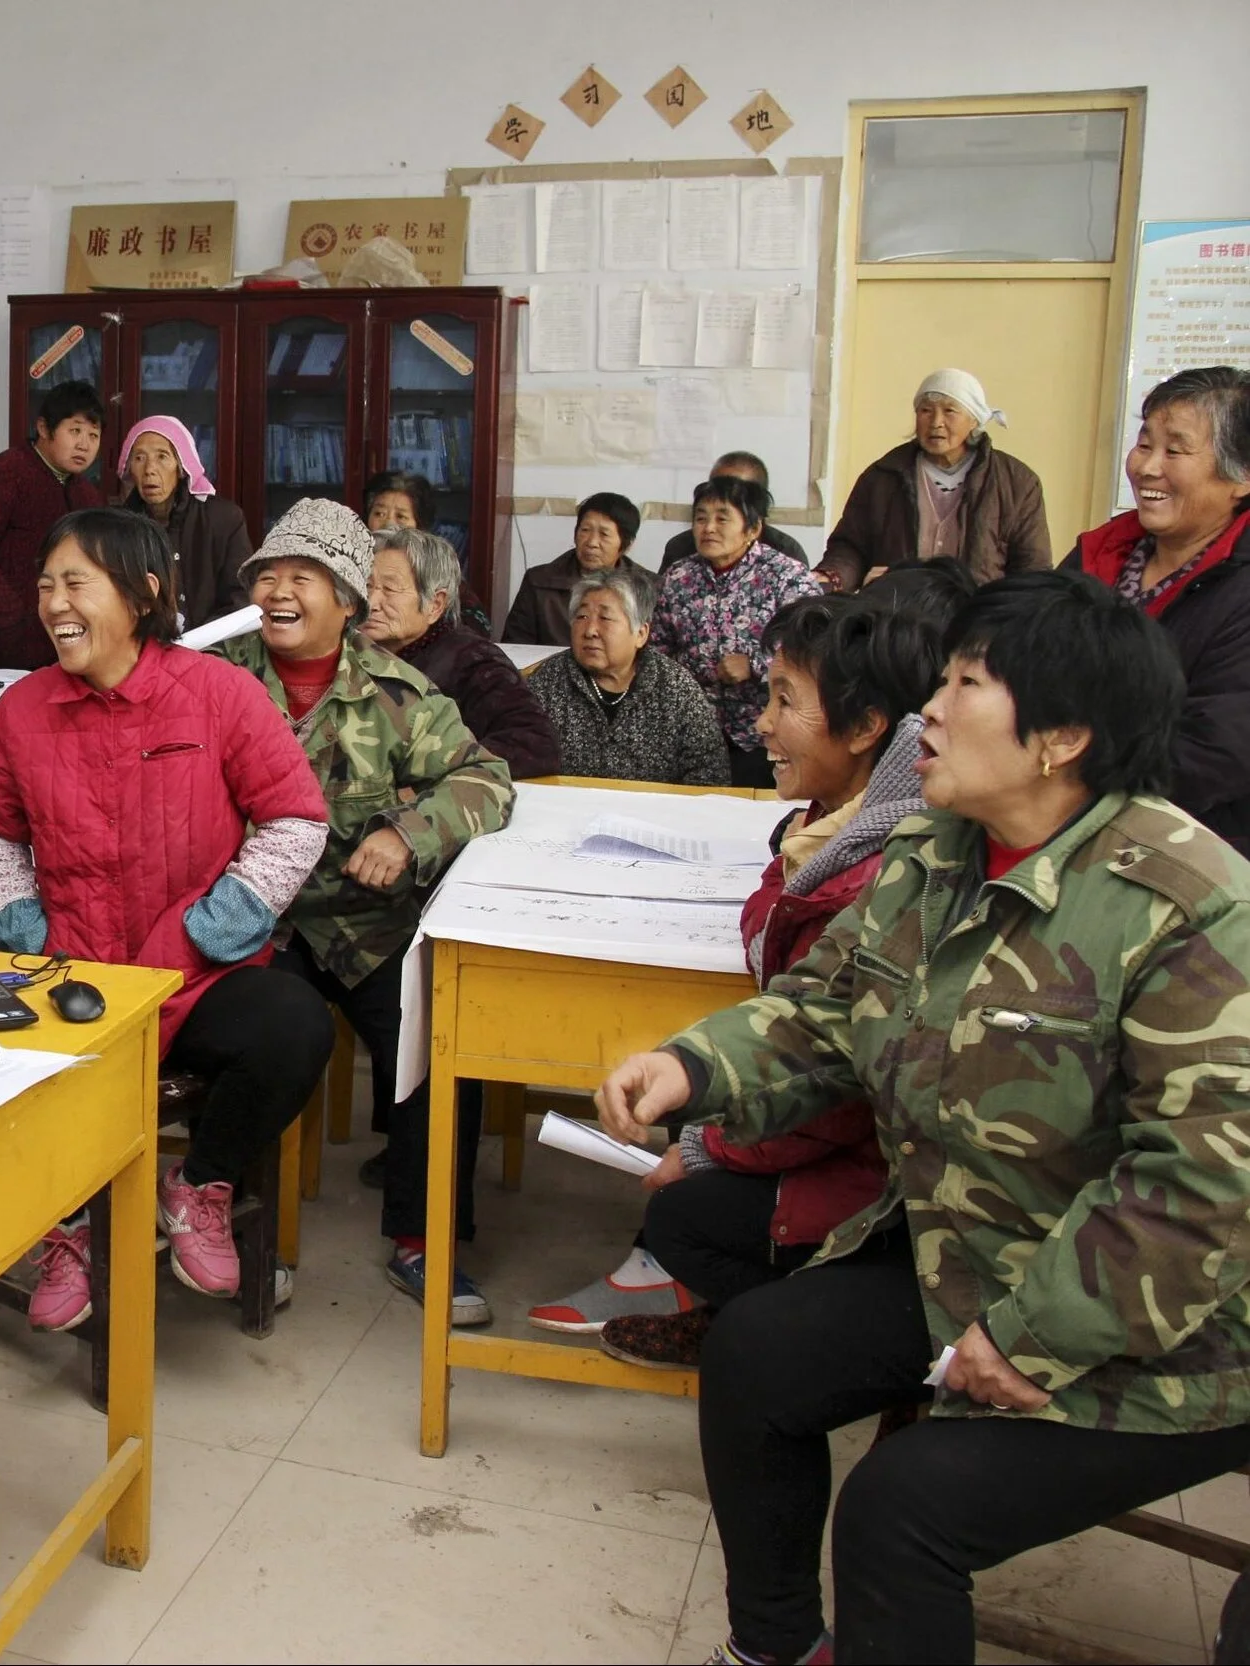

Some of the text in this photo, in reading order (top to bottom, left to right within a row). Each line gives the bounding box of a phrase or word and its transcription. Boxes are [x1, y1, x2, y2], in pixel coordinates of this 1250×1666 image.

[86, 224, 212, 257] 廉政书屋
[345, 222, 446, 240] 农家书屋
